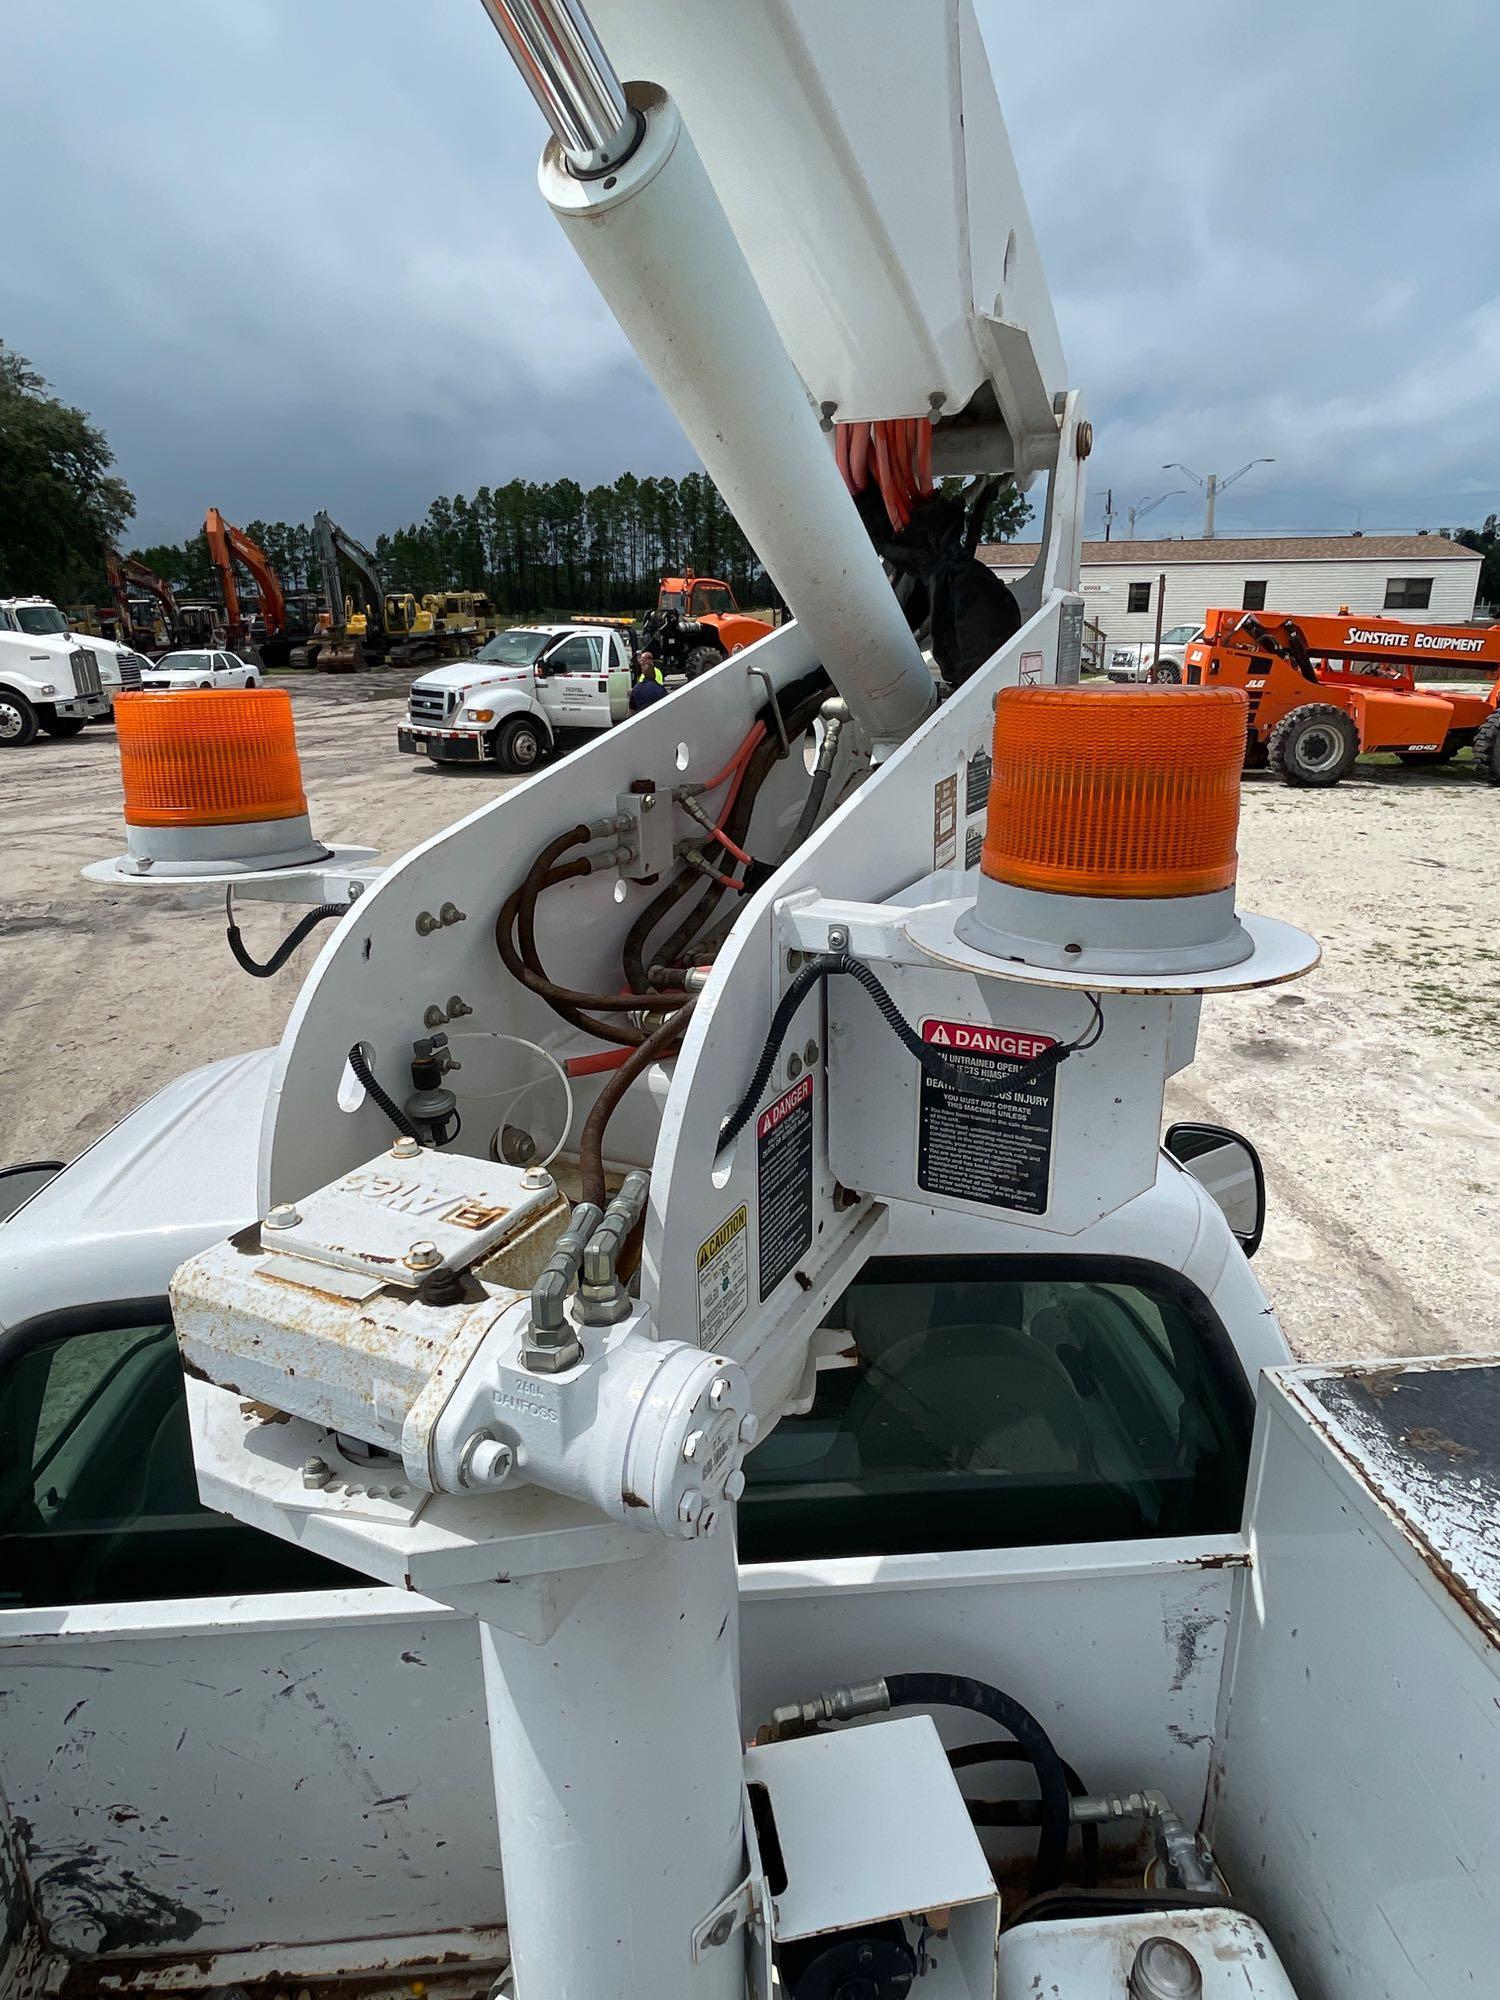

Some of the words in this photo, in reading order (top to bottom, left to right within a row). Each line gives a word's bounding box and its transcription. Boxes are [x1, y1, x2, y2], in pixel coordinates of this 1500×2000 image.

[1344, 627, 1409, 646] SUNSTATE
[1414, 633, 1485, 651] EQUIPMENT
[949, 1054, 994, 1068] UNTRAINED
[773, 1081, 808, 1123] DANGER
[943, 1093, 958, 1101] YOU
[959, 1096, 978, 1105] MUST
[997, 1103, 1031, 1114] OPERATE
[947, 1101, 962, 1109] THIS
[964, 1104, 996, 1115] MACHINE
[998, 1110, 1026, 1120] UNLESS
[1014, 1092, 1048, 1107] INJURY
[710, 1210, 744, 1256] CAUTION
[493, 1390, 559, 1423] DANFOSS
